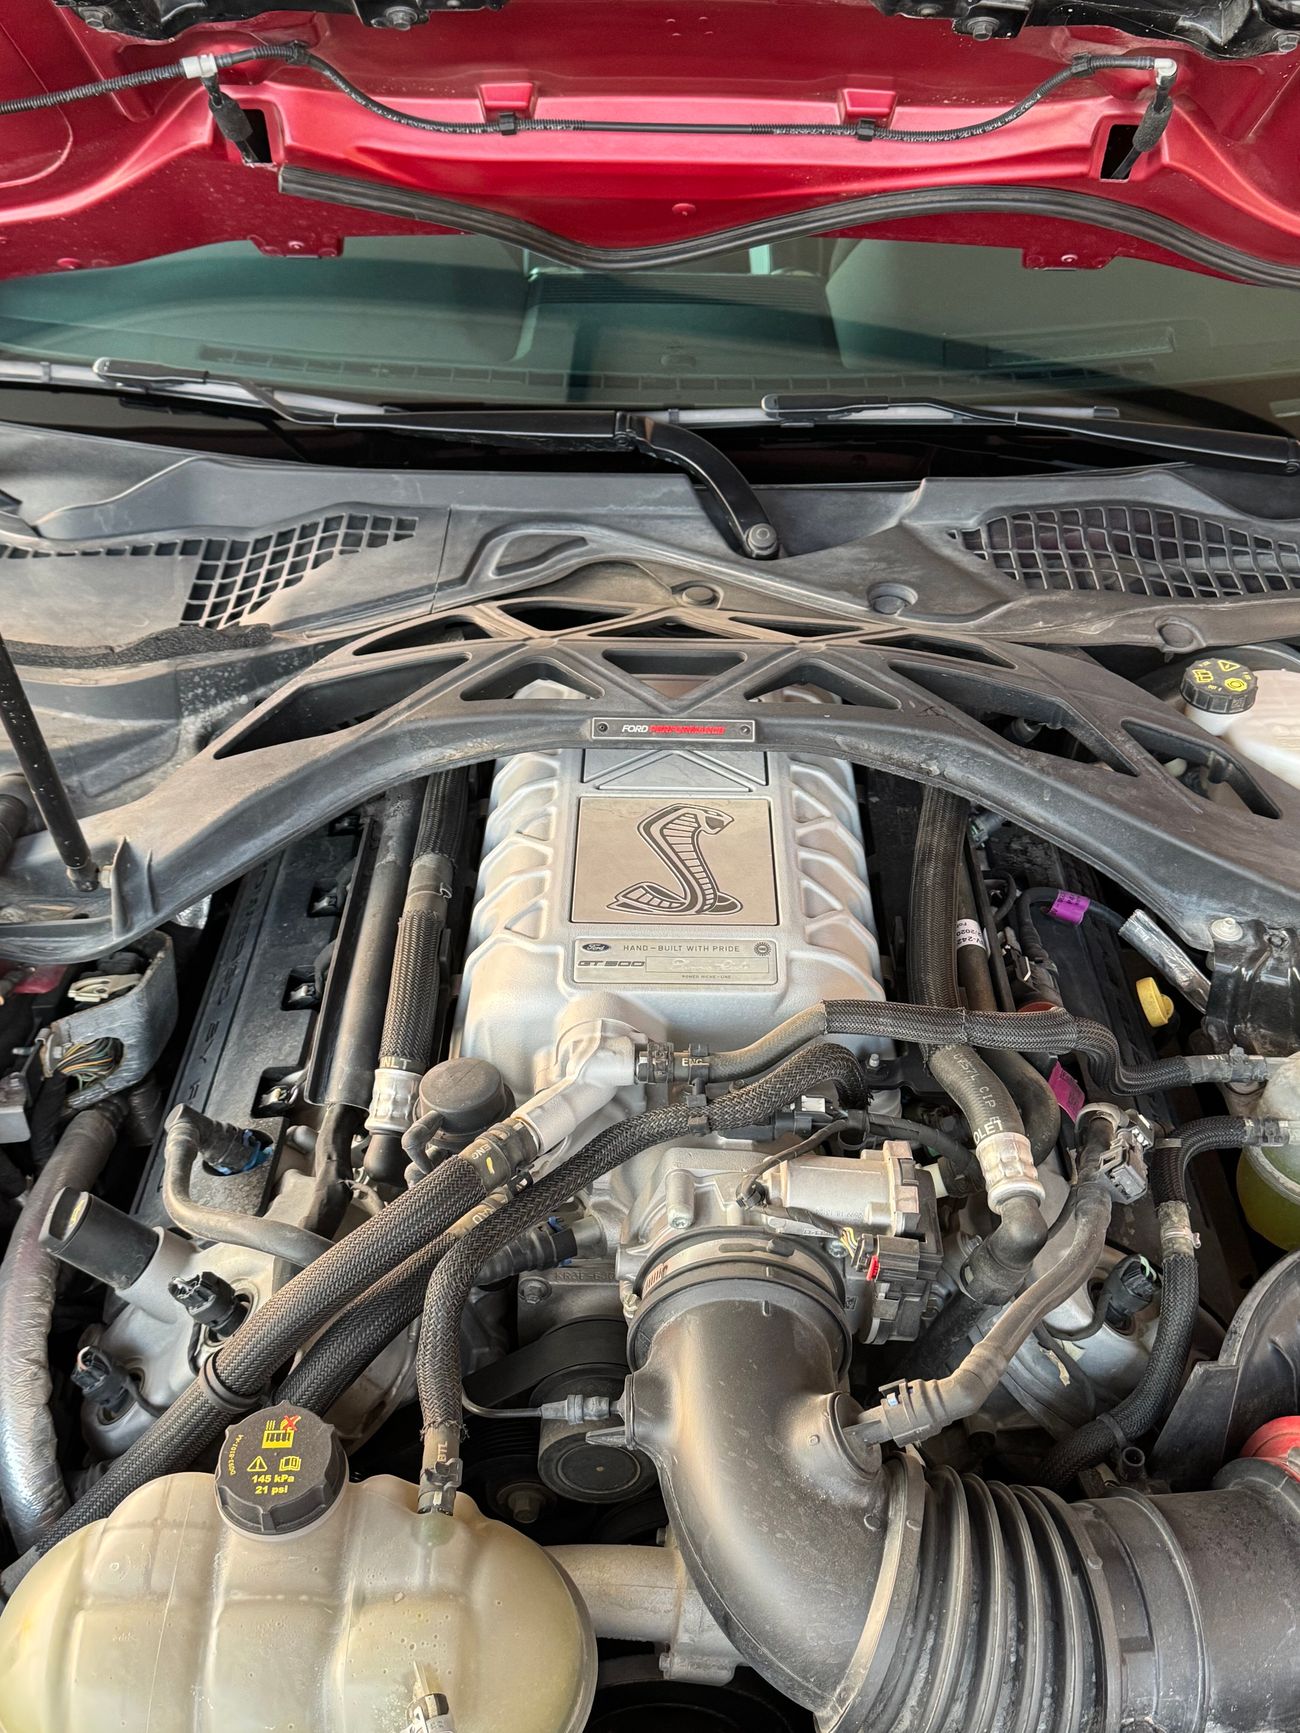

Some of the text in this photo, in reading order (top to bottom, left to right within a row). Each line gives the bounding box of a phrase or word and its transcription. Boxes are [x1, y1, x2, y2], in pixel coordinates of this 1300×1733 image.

[622, 724, 649, 733] FORD
[712, 945, 740, 953] PRIDE
[471, 1143, 492, 1160] ENG
[437, 1440, 448, 1462] BTL
[251, 1474, 295, 1484] 145 kPa
[254, 1484, 289, 1495] 21 psi
